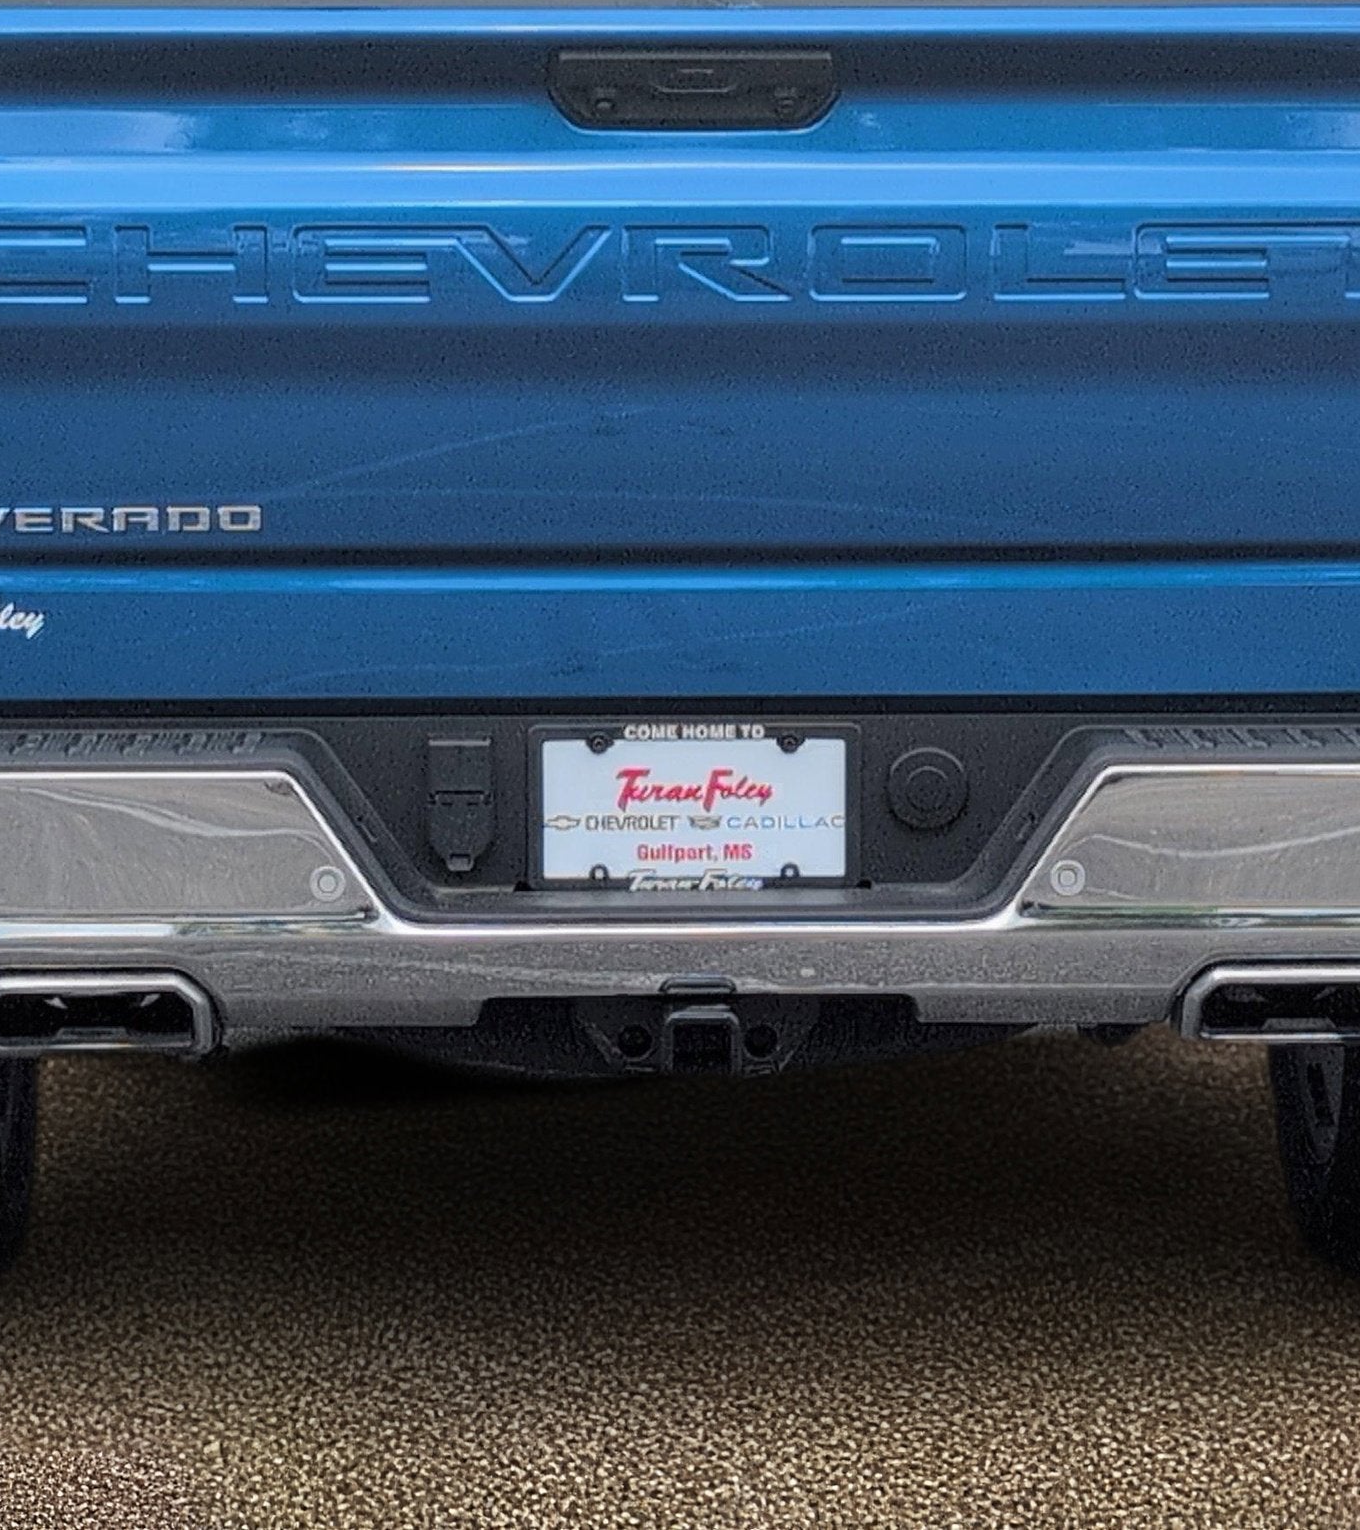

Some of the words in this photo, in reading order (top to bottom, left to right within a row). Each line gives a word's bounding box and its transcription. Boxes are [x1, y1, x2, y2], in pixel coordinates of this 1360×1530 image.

[624, 724, 678, 739] COME
[682, 724, 736, 739] HOME
[585, 815, 677, 831] CHEVROLET
[726, 815, 846, 830] CADILLAC
[723, 845, 752, 861] MS
